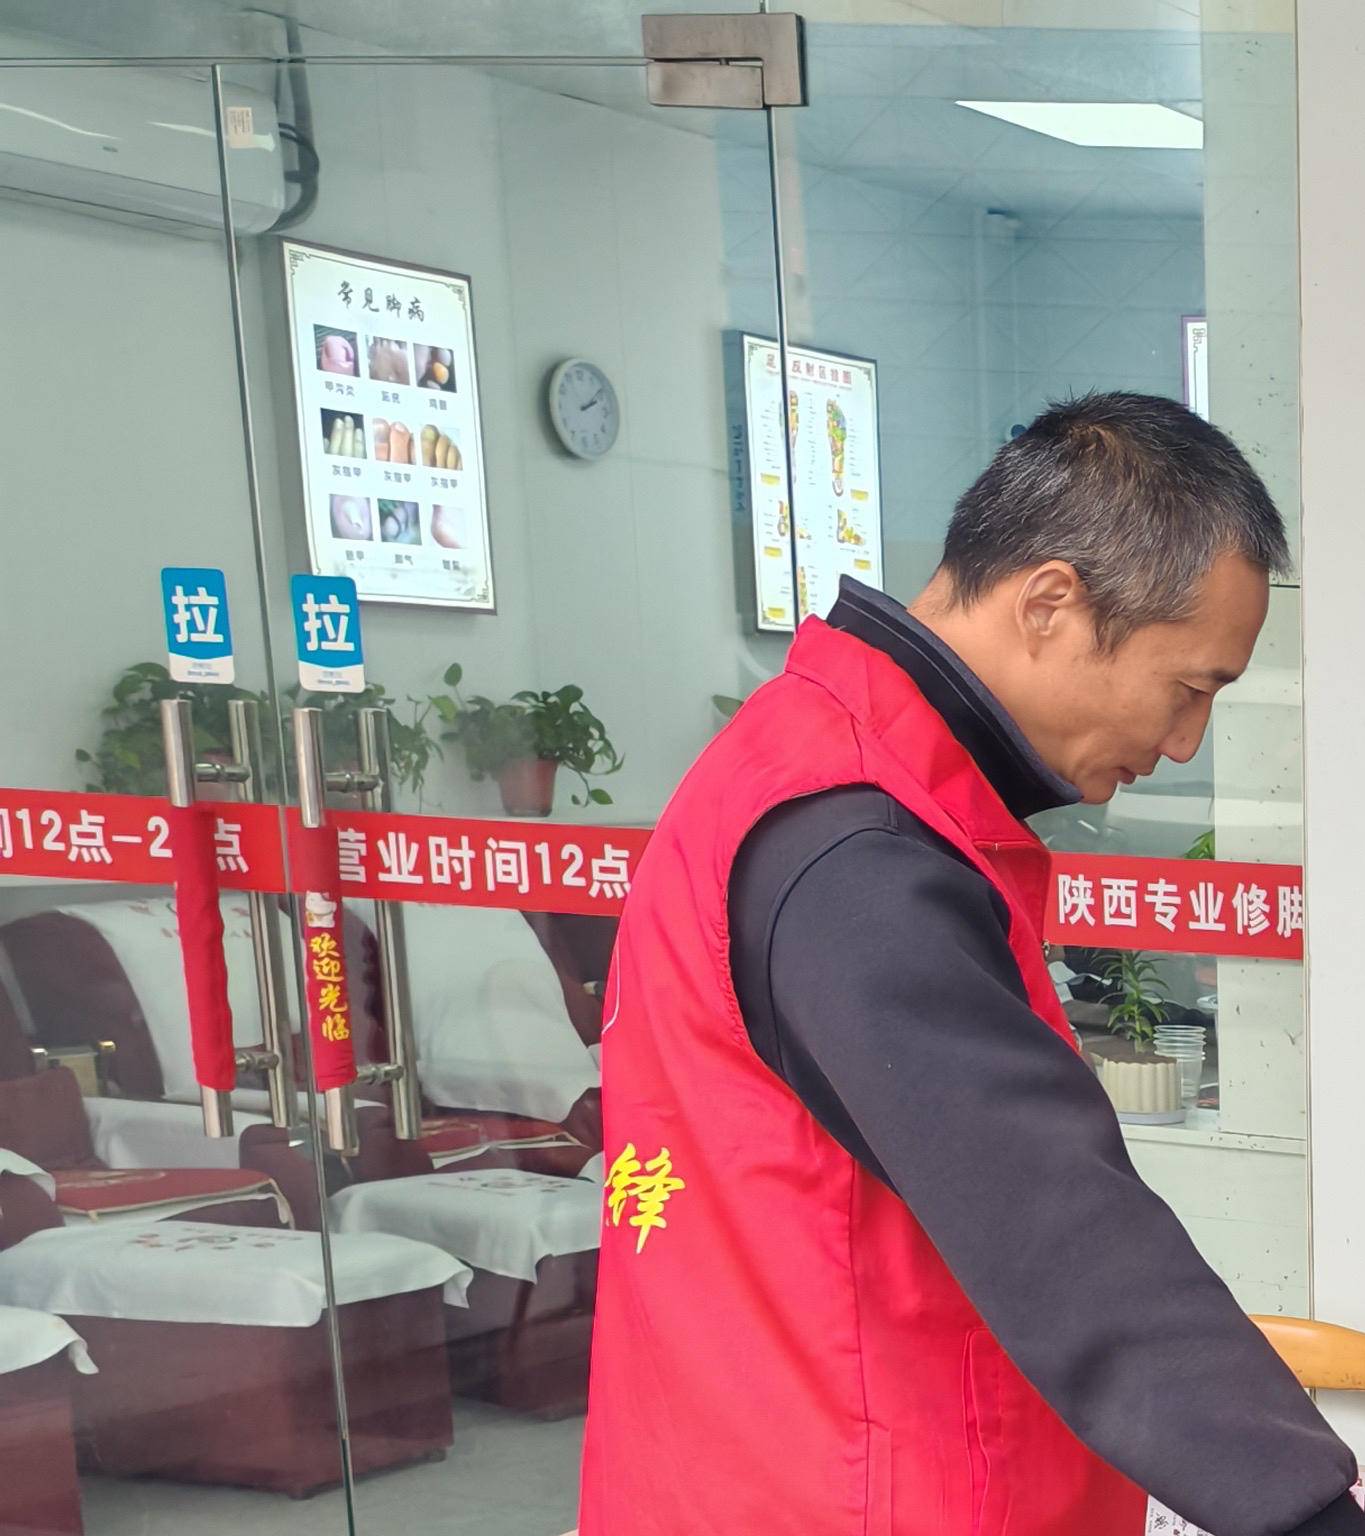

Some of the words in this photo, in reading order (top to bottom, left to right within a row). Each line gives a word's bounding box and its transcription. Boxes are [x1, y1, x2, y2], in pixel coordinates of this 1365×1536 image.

[338, 280, 425, 322] 常见脚病
[171, 586, 224, 643] 拉
[302, 593, 355, 651] 拉
[309, 932, 351, 1042] 欢迎光临
